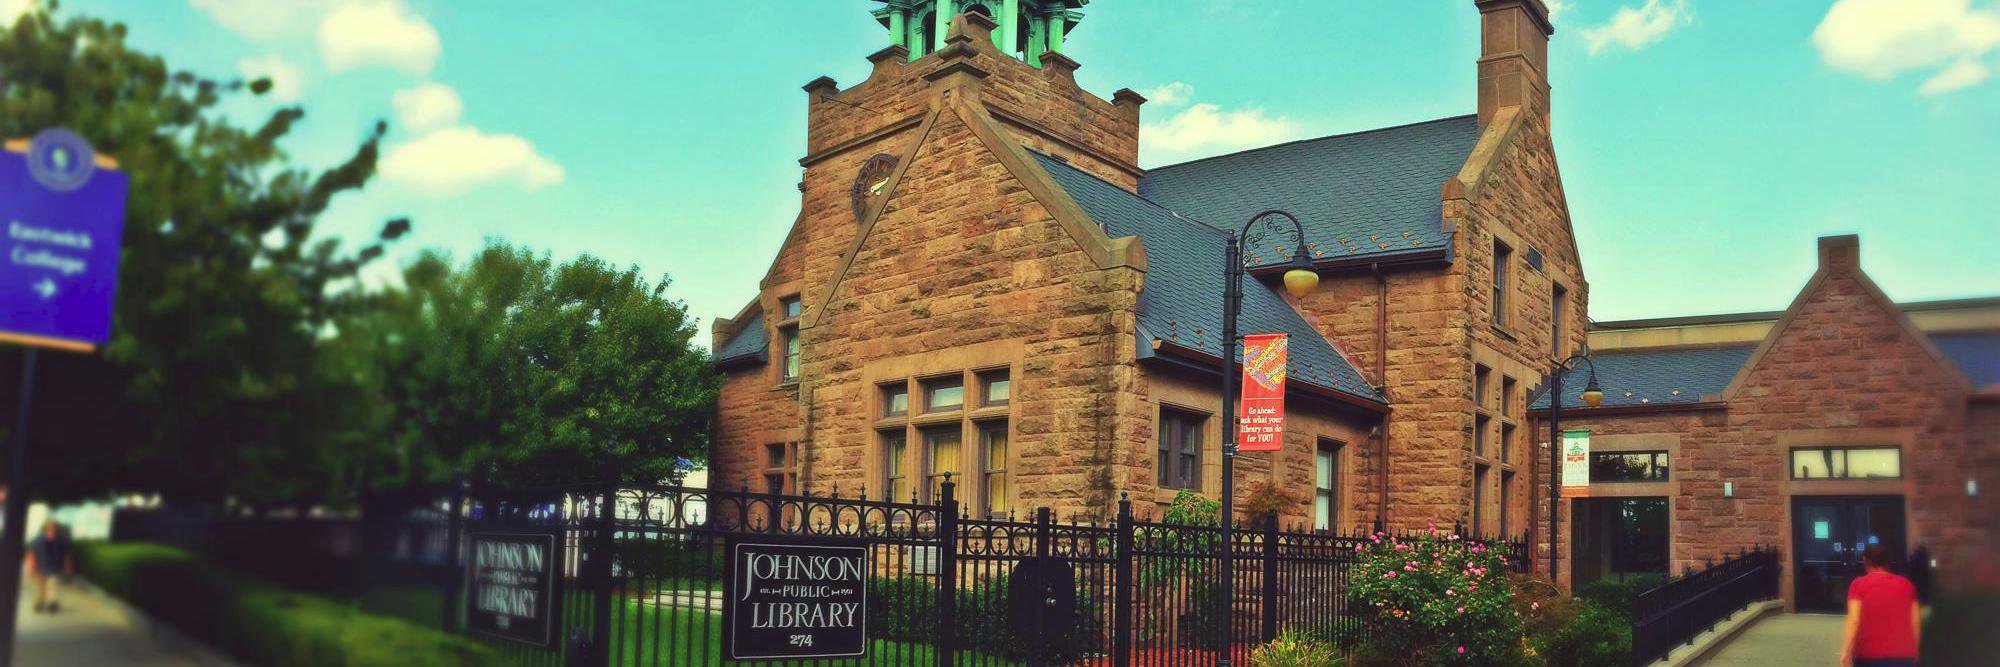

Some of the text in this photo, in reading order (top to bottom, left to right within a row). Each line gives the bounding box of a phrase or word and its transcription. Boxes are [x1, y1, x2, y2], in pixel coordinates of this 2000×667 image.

[1248, 406, 1256, 415] Go
[1240, 415, 1283, 425] ask what your
[1241, 425, 1261, 434] library
[1274, 424, 1282, 432] do
[1247, 434, 1257, 443] for
[475, 540, 544, 573] JOHNSON
[743, 552, 862, 601] JOHNSON
[782, 585, 830, 598] PUBLIC
[478, 583, 540, 618] LIBRARY
[752, 602, 859, 628] LIBRARY
[789, 634, 813, 647] 274
